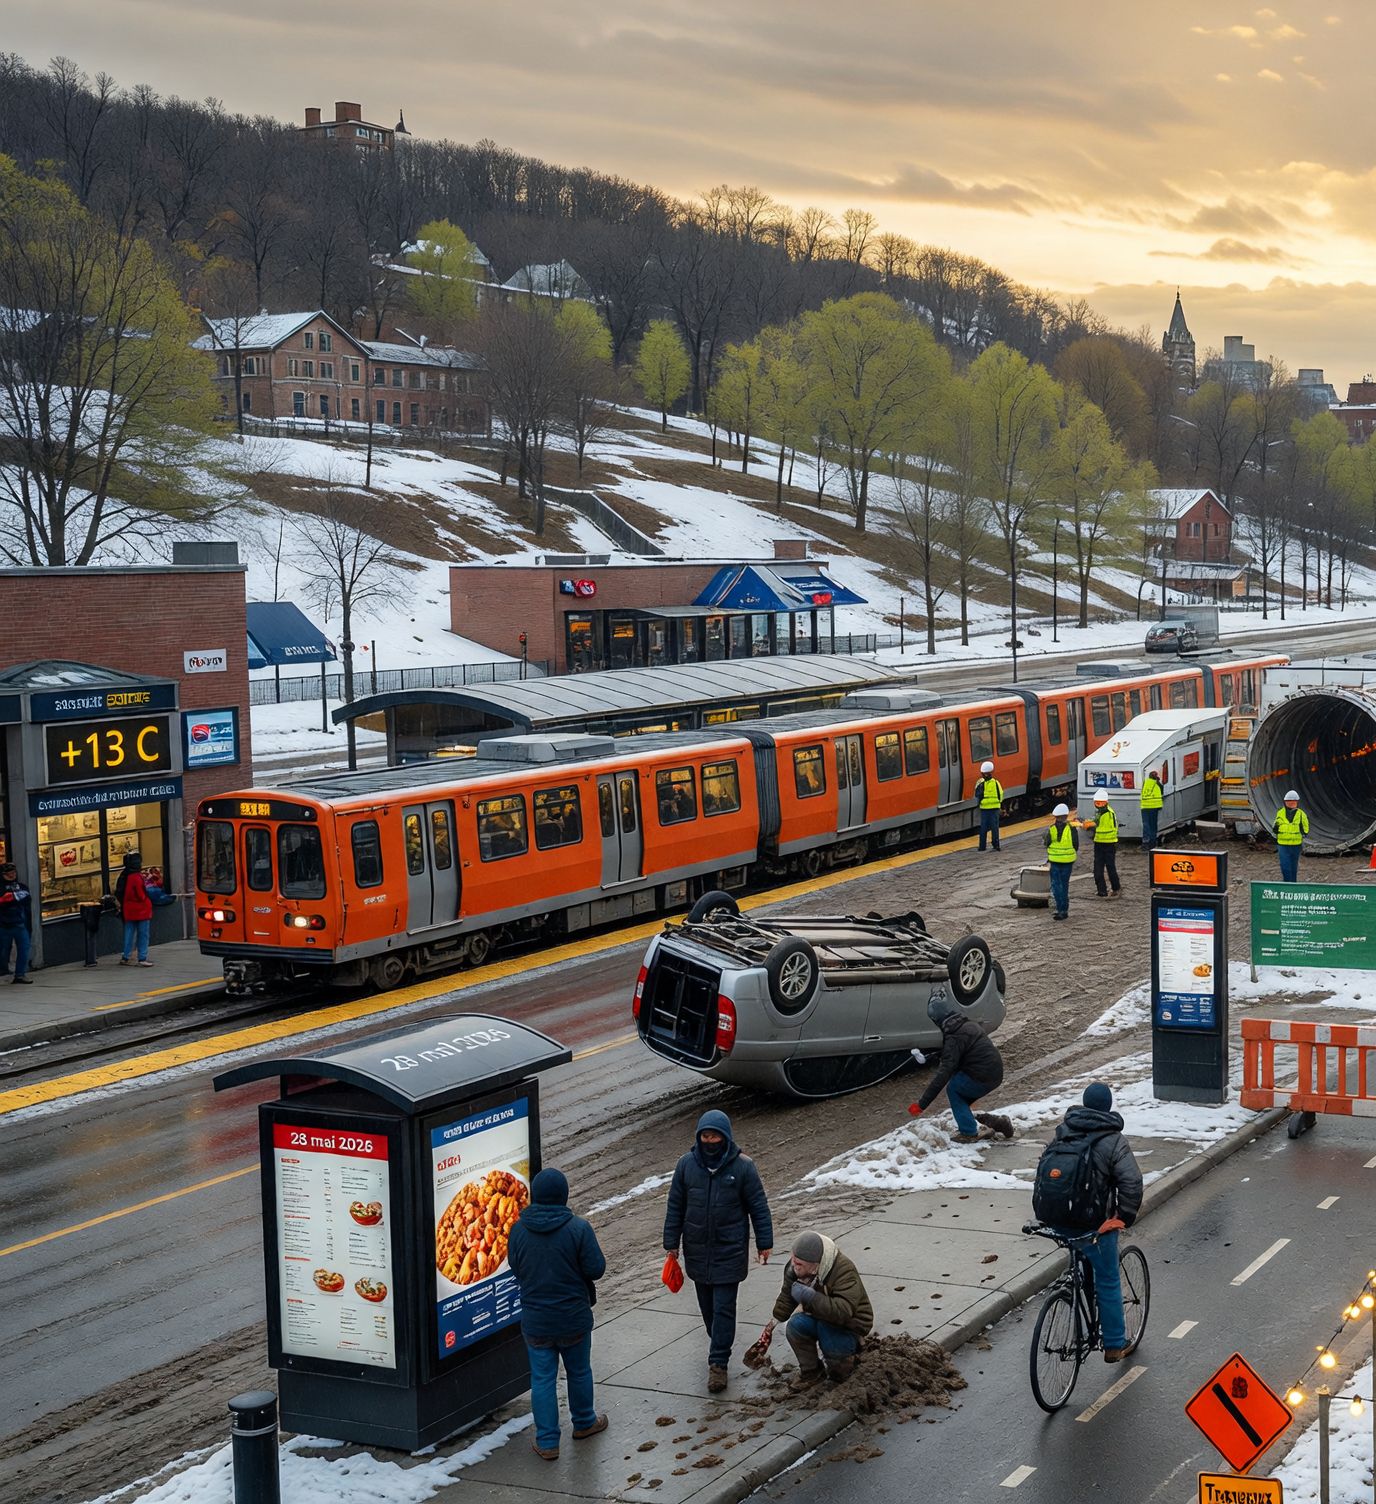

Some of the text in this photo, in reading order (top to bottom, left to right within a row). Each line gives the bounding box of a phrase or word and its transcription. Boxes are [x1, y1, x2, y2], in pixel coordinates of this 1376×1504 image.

[60, 729, 125, 768] +13
[136, 725, 160, 762] C
[290, 1132, 373, 1153] 28 mai 2026
